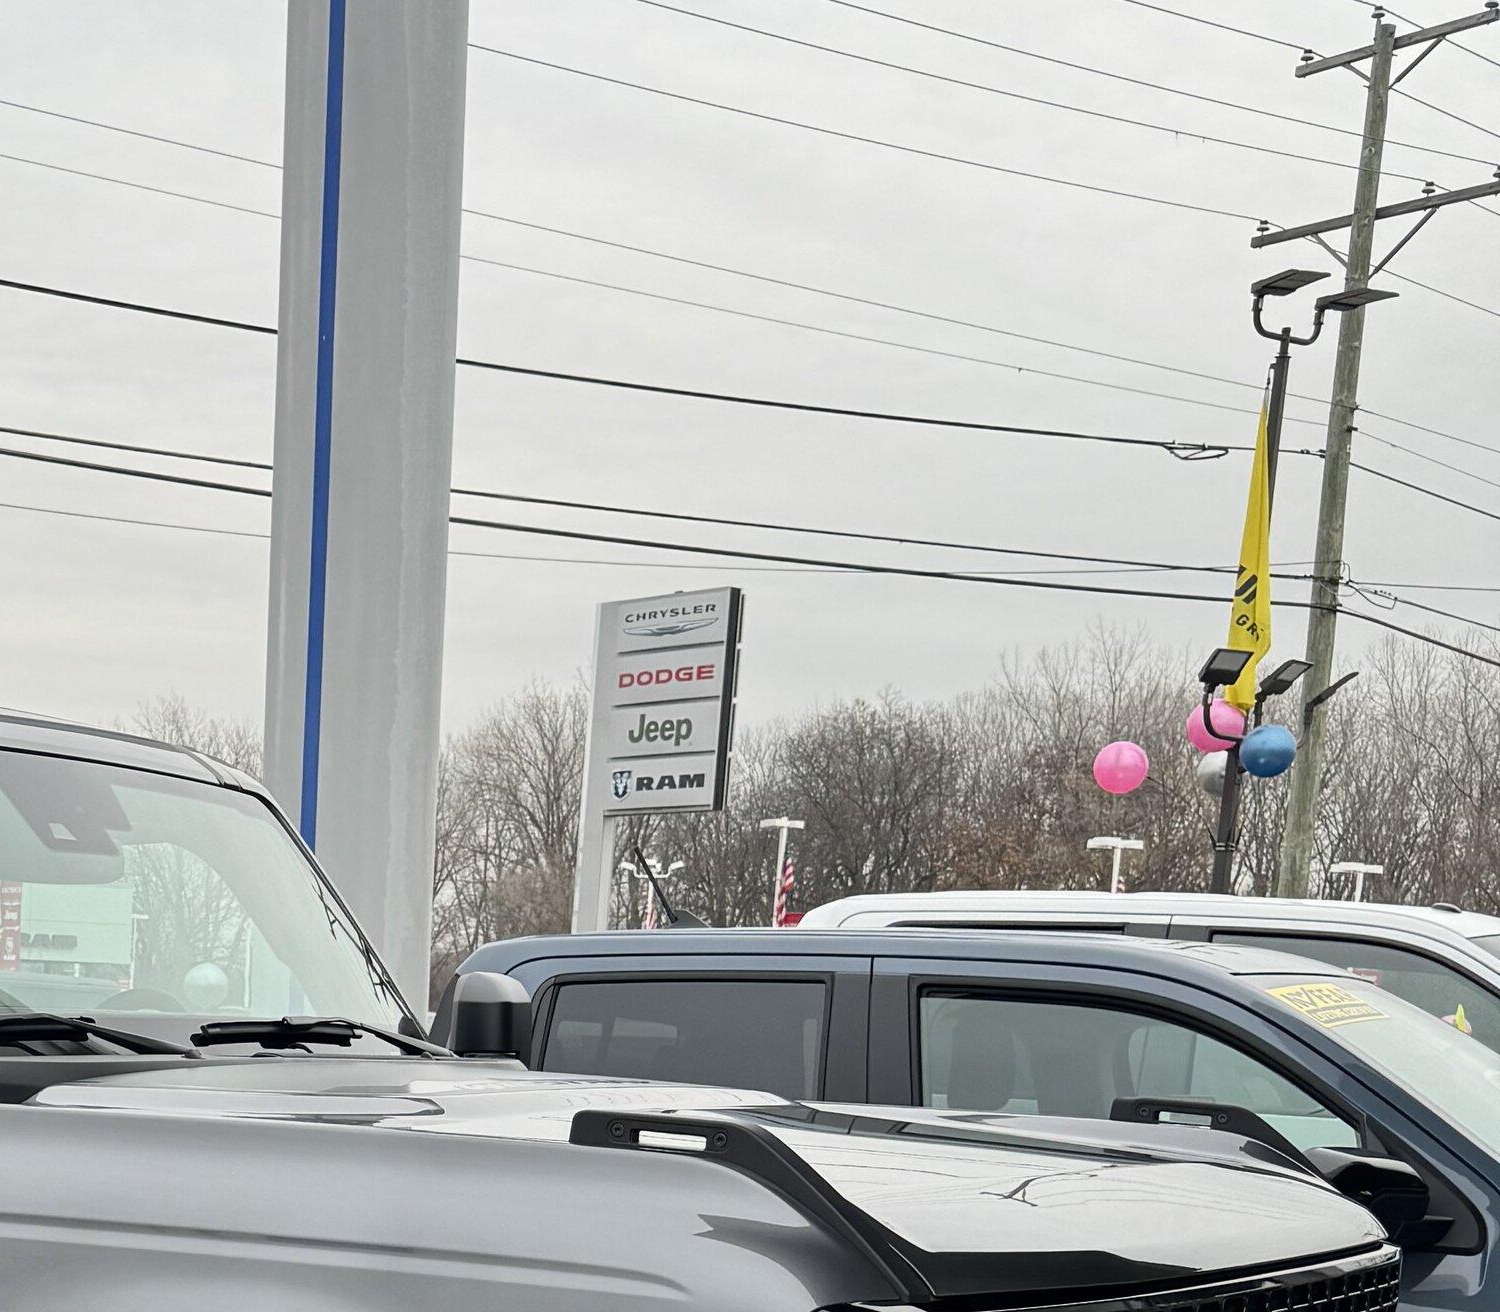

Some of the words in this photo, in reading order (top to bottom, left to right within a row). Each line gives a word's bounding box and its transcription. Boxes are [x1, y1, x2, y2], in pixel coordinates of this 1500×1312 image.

[625, 604, 717, 623] CHRYSLER
[618, 664, 715, 689] DODGE
[628, 714, 693, 746] Jeep
[636, 773, 706, 791] RAM
